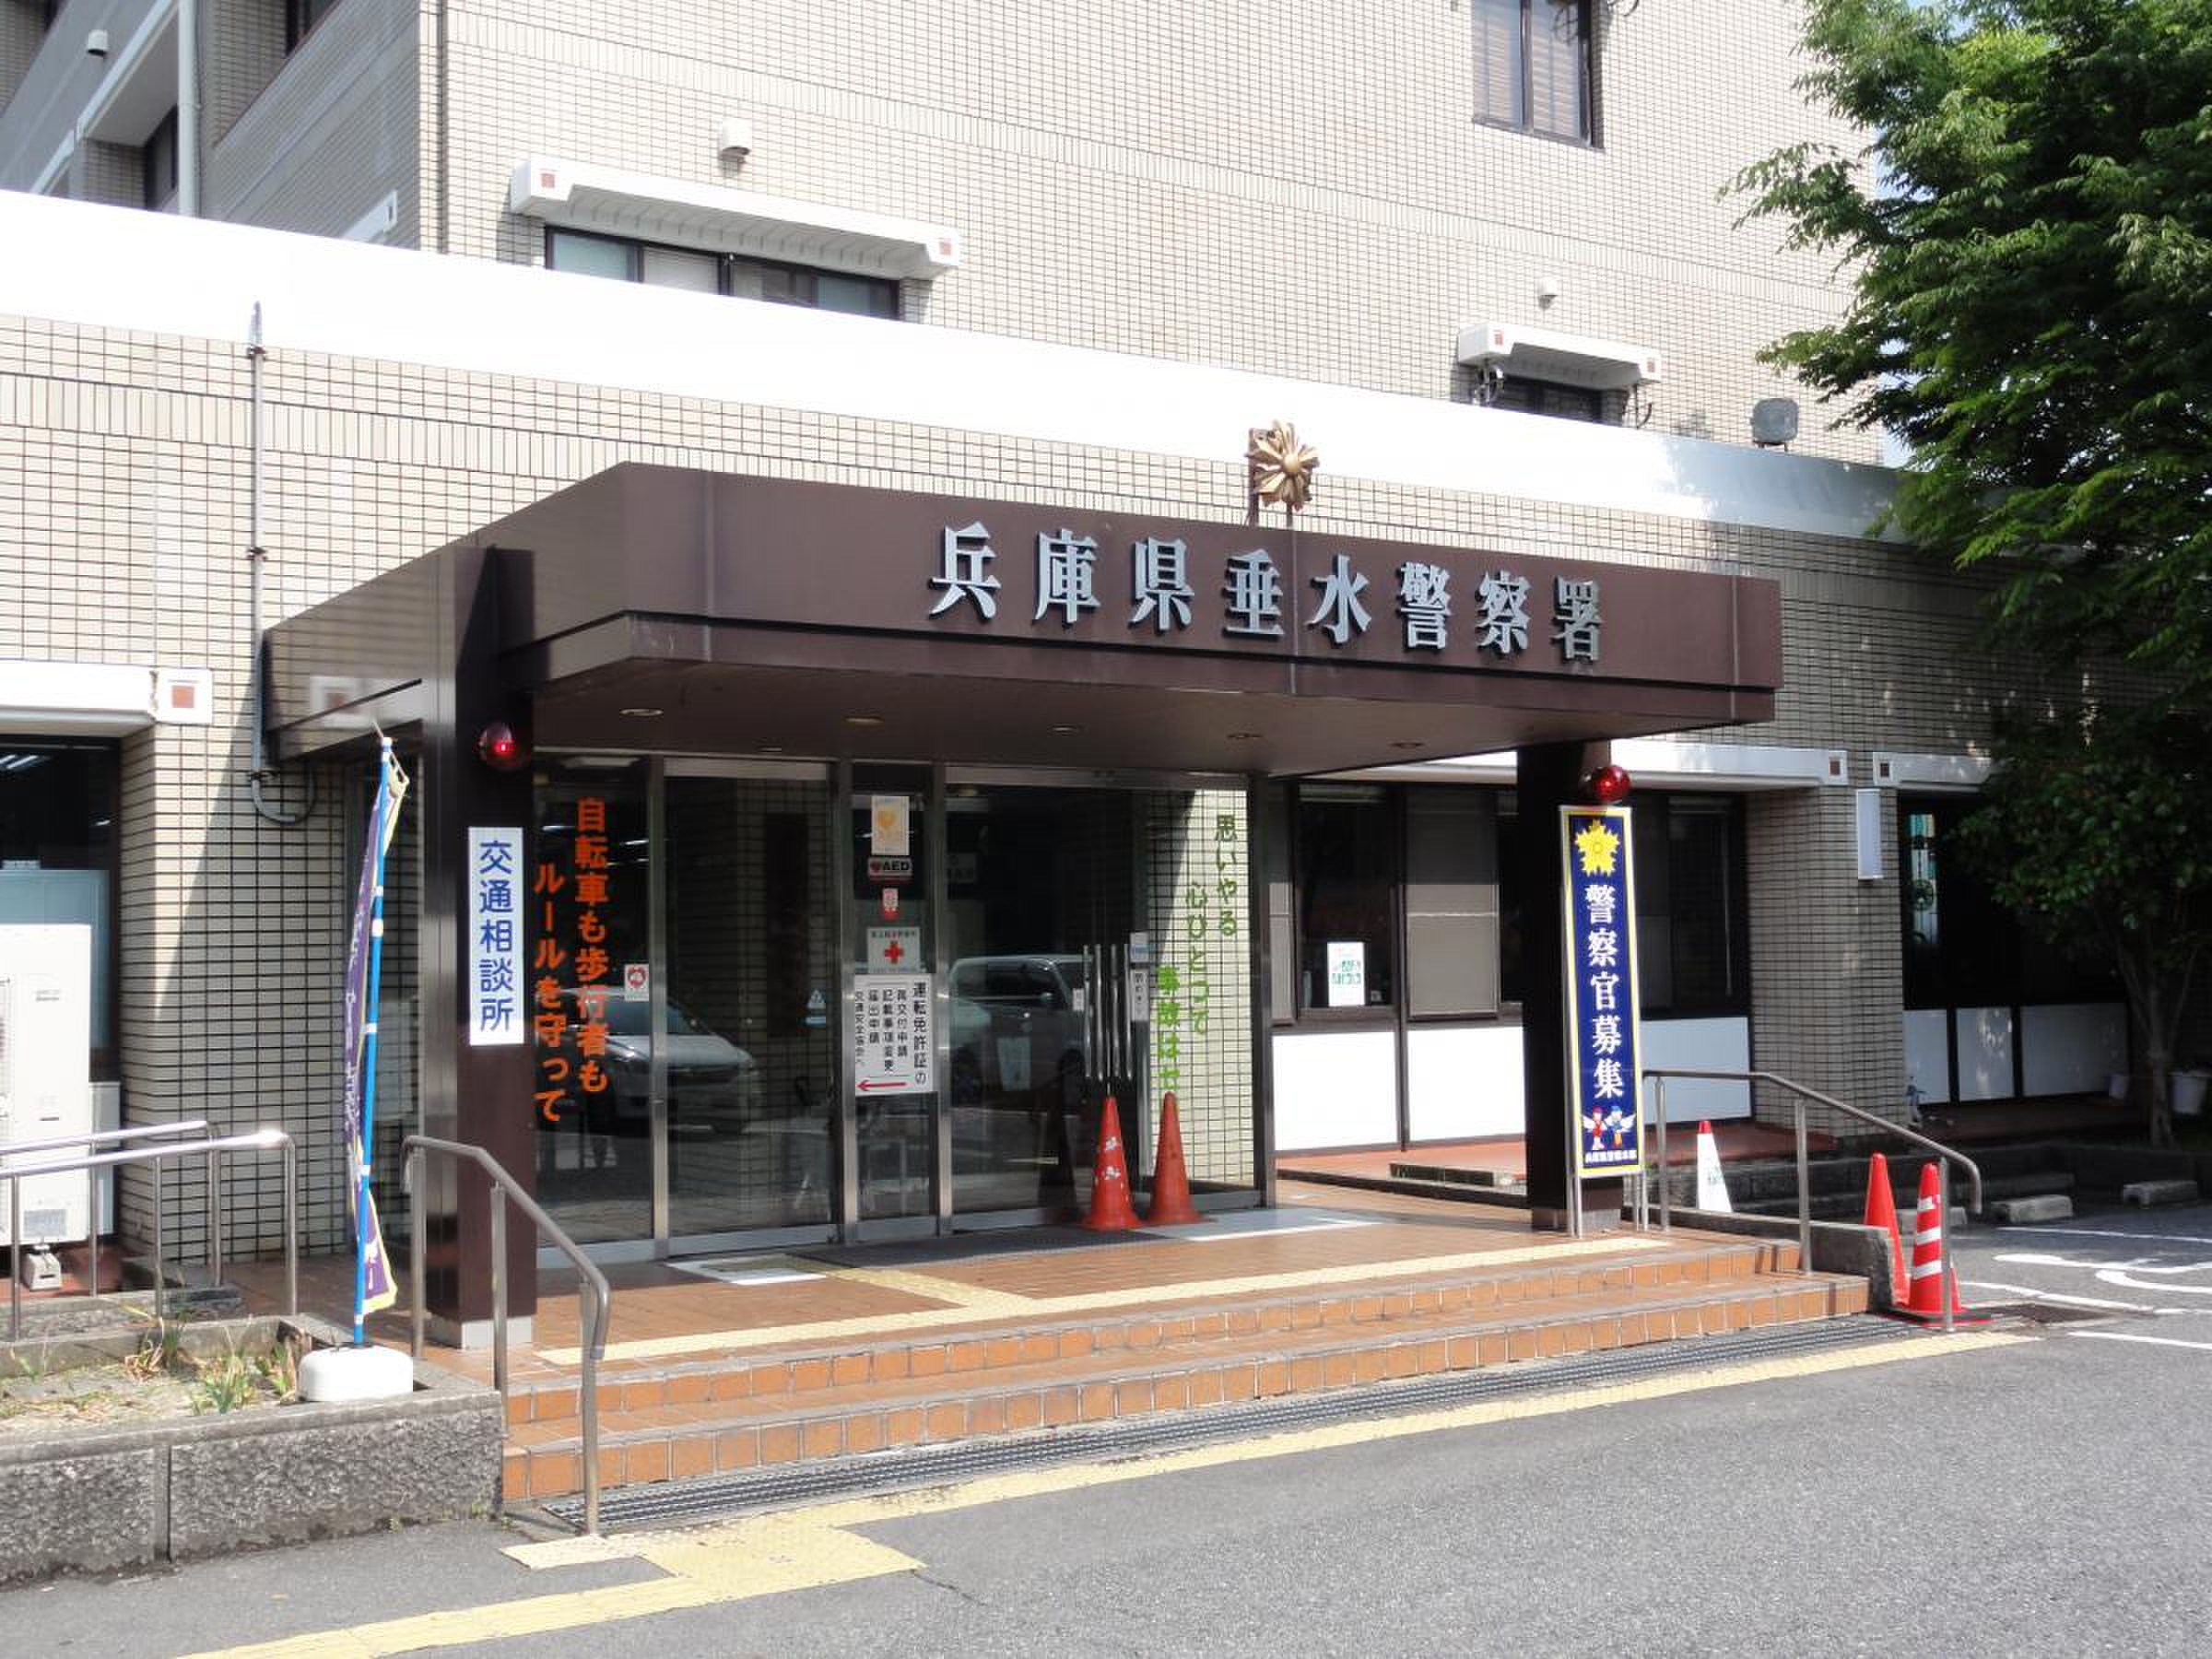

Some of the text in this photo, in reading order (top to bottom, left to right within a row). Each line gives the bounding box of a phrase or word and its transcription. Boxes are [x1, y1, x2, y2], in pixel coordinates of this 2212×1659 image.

[929, 520, 1604, 661] 兵庫県垂水警察署
[478, 840, 514, 1031] 交通相談所
[575, 796, 610, 1093] 自転車も歩行者も
[883, 860, 911, 871] AED
[1214, 814, 1239, 937] 思いやる
[533, 863, 570, 1122] ルールを守って
[912, 982, 927, 1084] 運転免許証の
[1583, 883, 1626, 1100] 警察官募集
